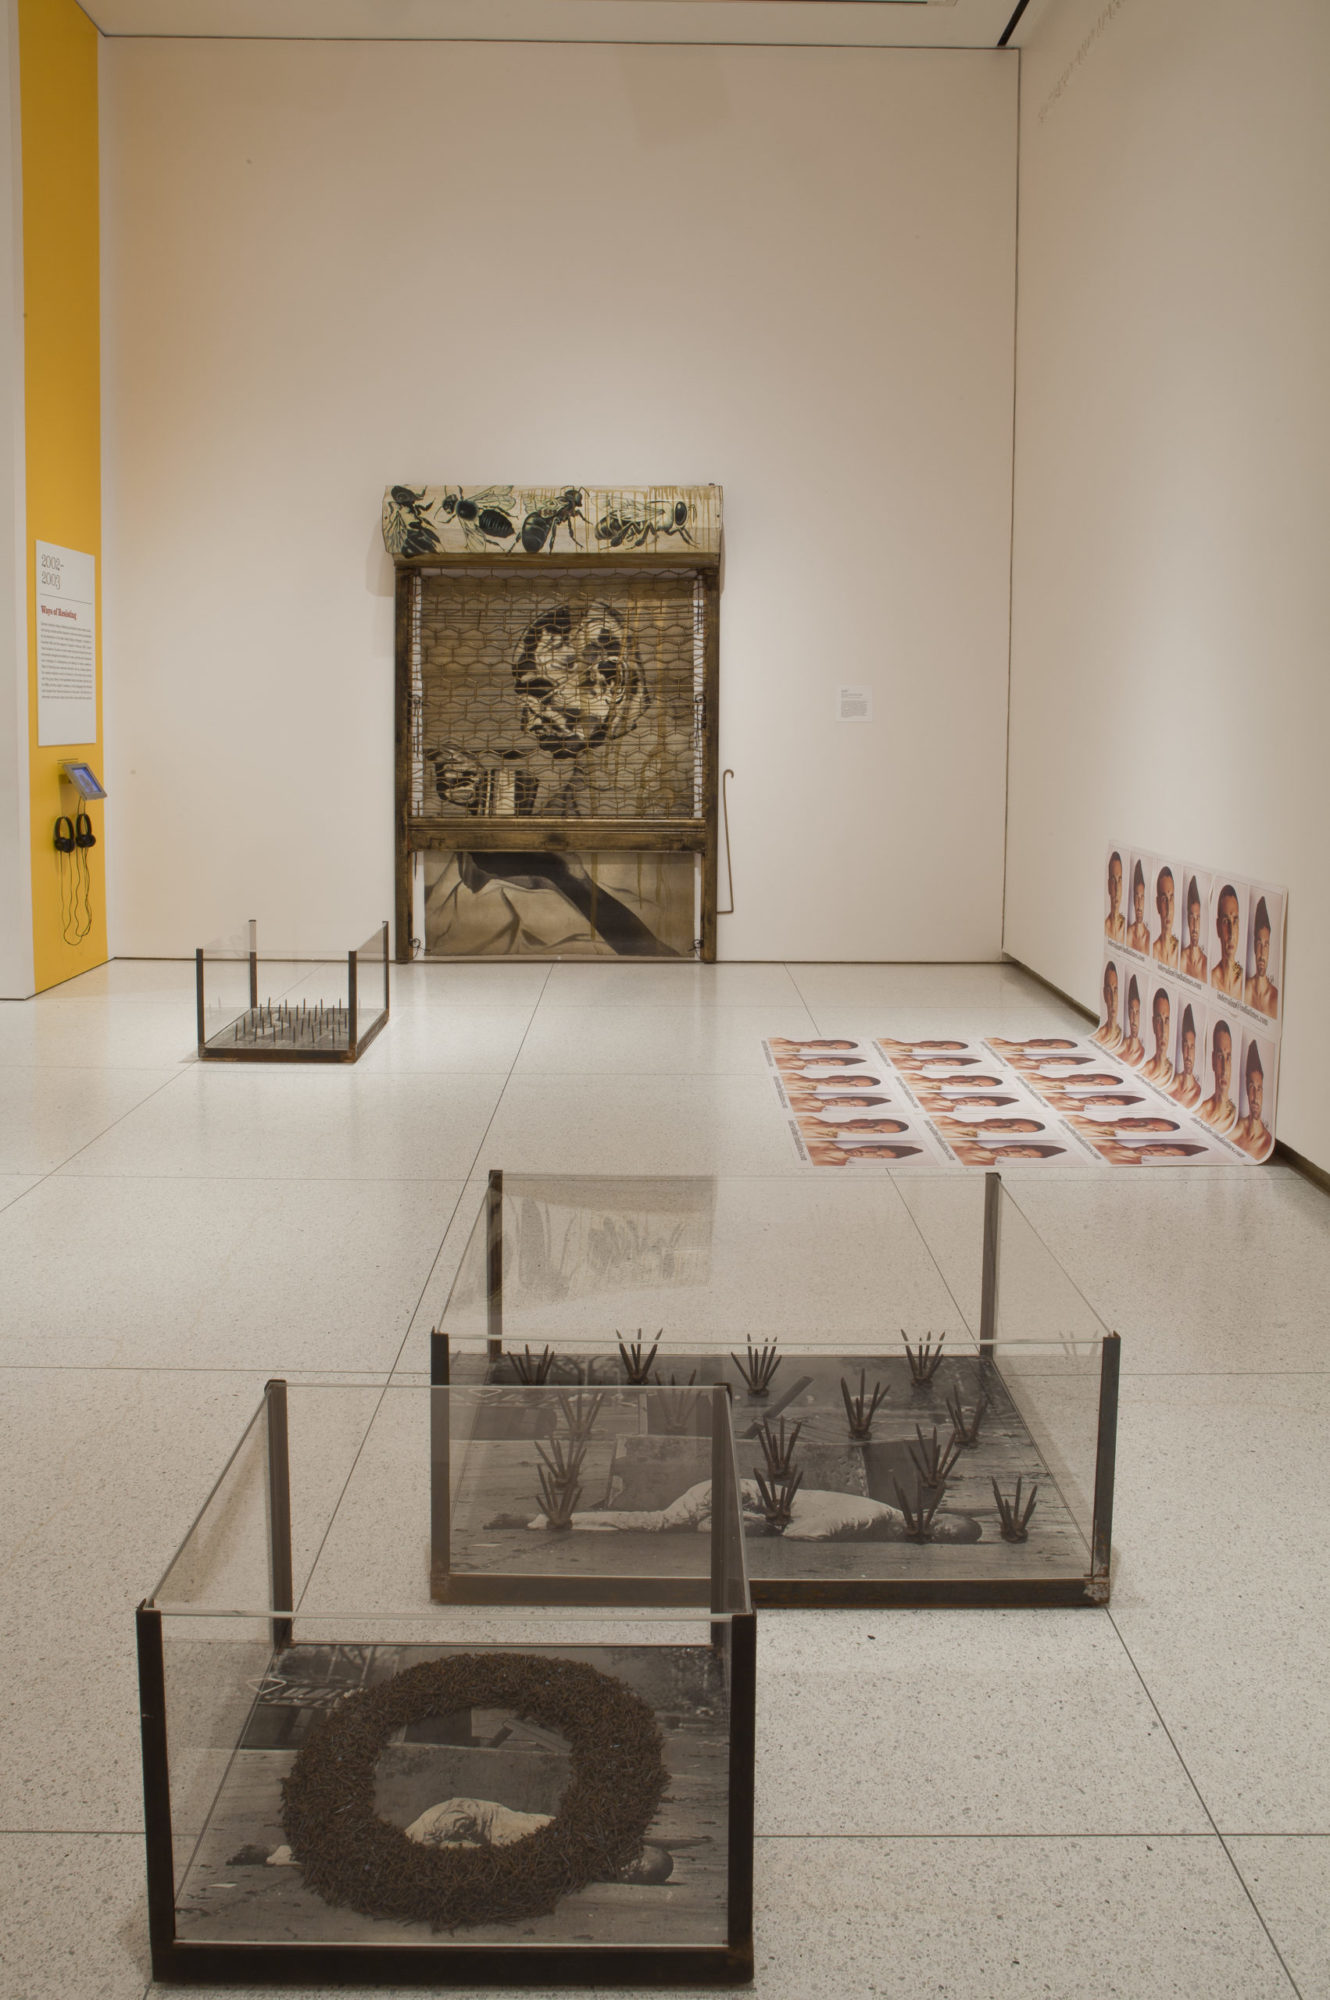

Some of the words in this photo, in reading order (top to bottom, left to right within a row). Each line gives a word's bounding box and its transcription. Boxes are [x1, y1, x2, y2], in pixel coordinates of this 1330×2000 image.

[41, 553, 64, 571] 2002-
[41, 571, 61, 590] 2003
[41, 605, 52, 616] Ways
